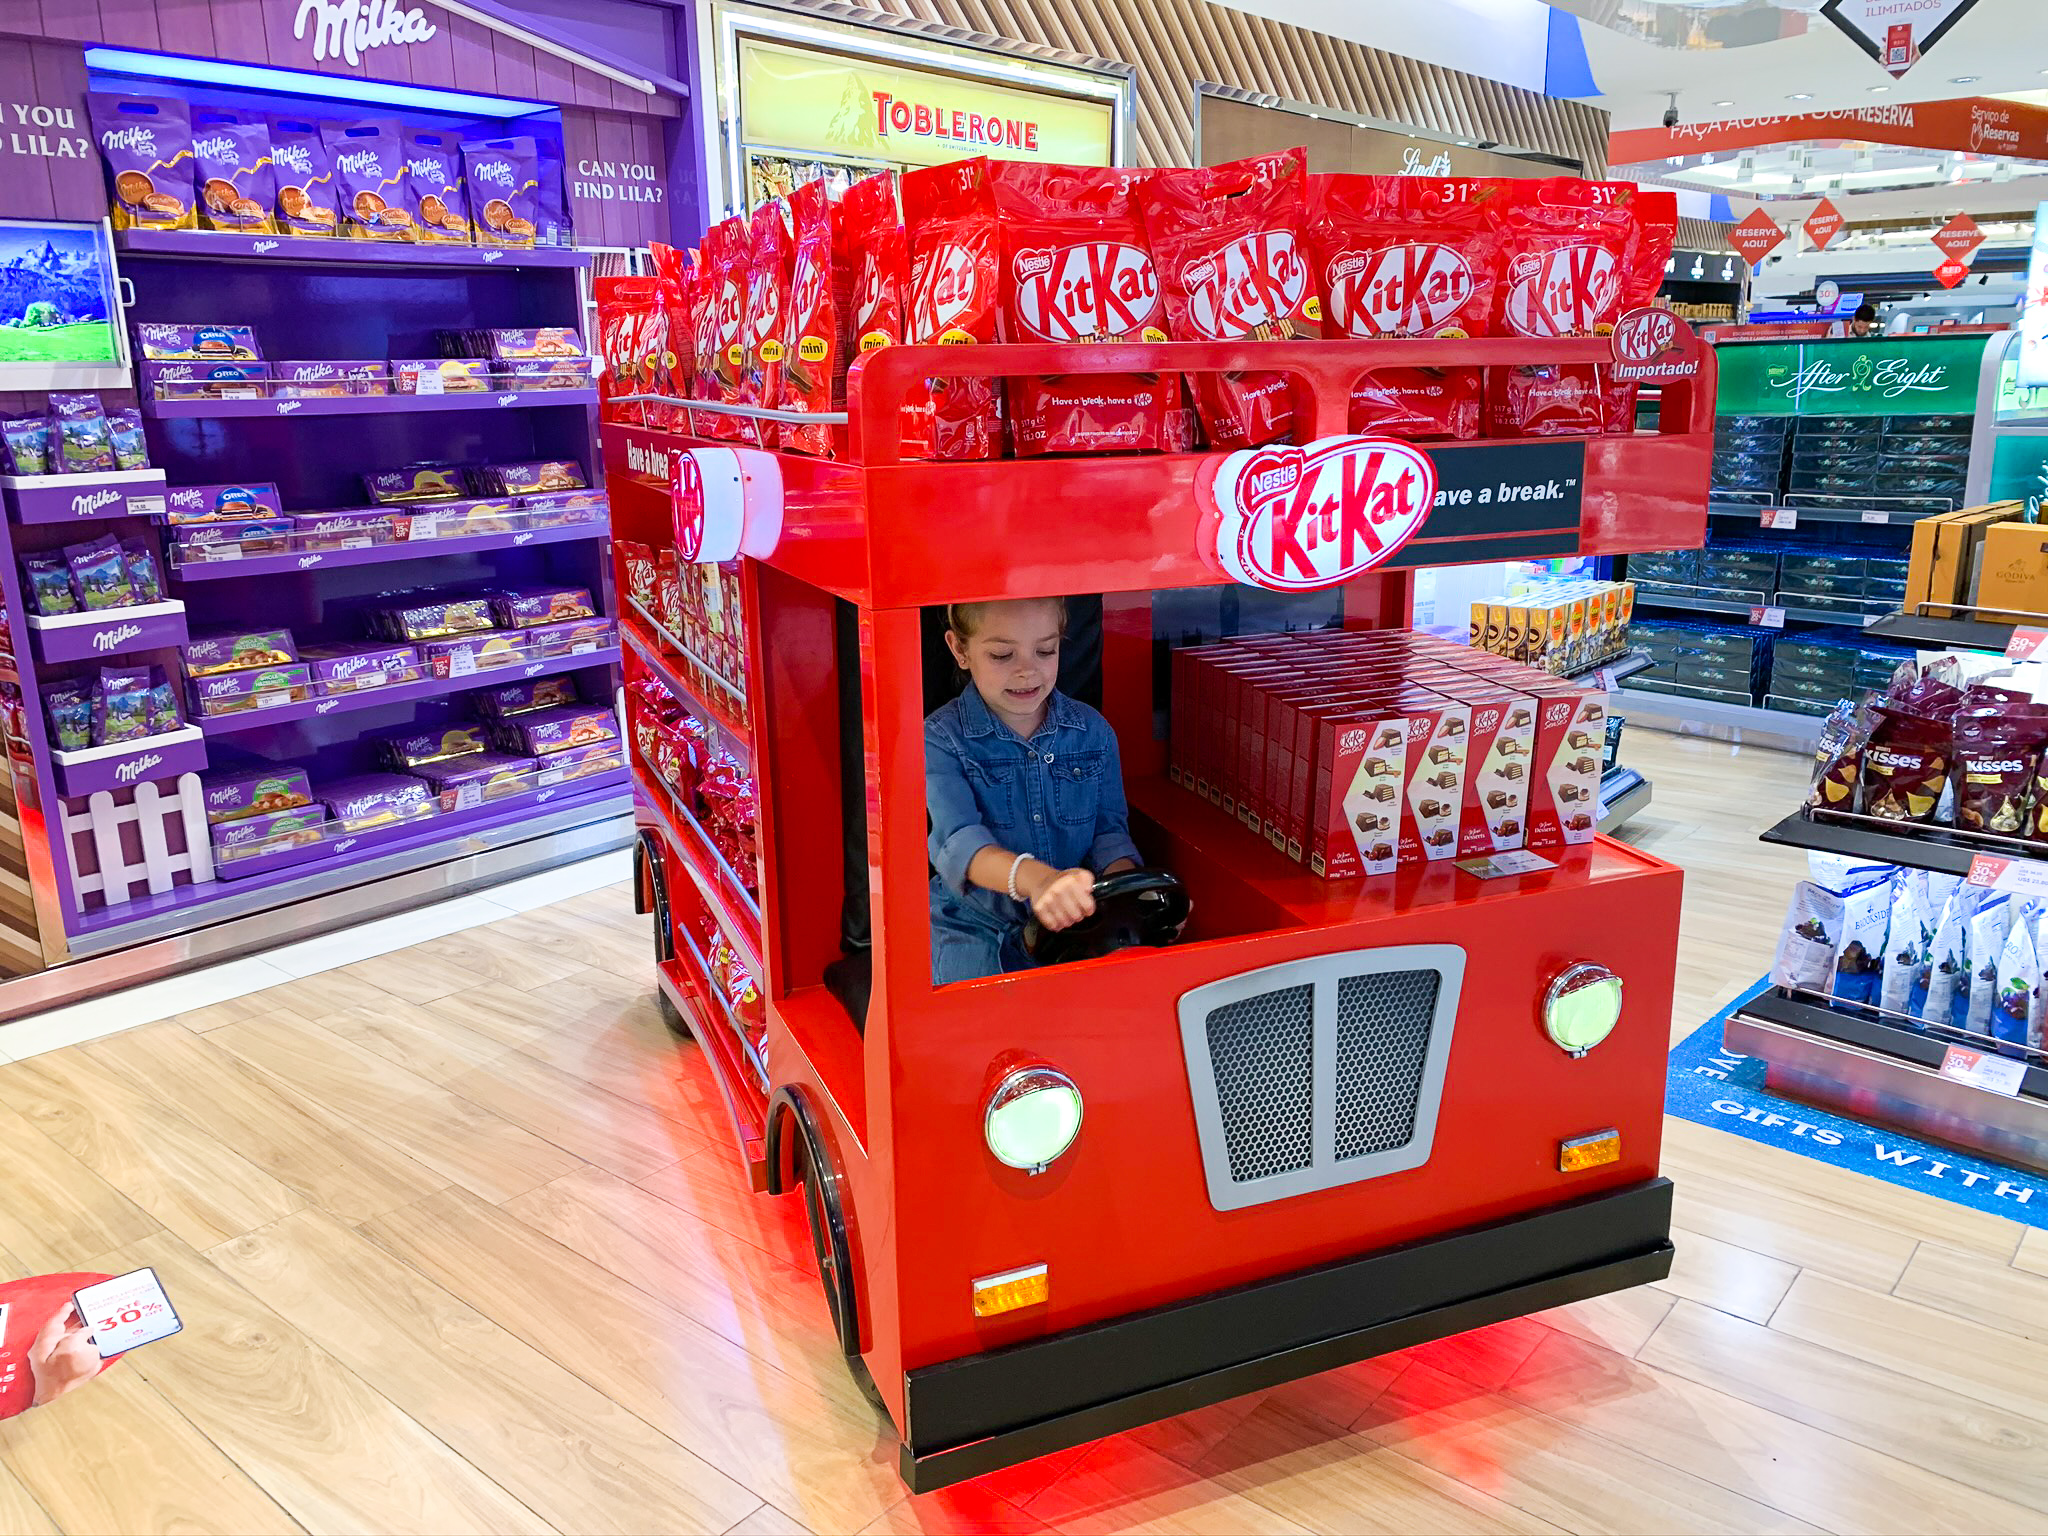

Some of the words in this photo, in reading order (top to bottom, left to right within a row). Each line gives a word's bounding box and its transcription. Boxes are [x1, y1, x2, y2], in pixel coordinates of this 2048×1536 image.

[1865, 0, 1941, 17] ILIMITADOS
[294, 0, 437, 66] Milka
[12, 103, 75, 129] YOU
[872, 91, 1038, 152] TOBLERONE
[1670, 121, 1722, 140] FAÇA
[1857, 105, 1914, 128] RESERVA
[1971, 105, 1999, 125] Serviço
[2000, 109, 2010, 123] de
[101, 126, 155, 150] Milka
[1983, 124, 2019, 142] Reservas
[11, 133, 89, 159] LILA?
[192, 136, 236, 159] Milka
[271, 145, 311, 166] Milka
[337, 150, 379, 174] Milka
[1398, 147, 1442, 176] Lindt
[408, 158, 442, 178] Milka
[474, 161, 512, 181] Milka
[578, 160, 615, 178] CAN
[620, 163, 655, 181] YOU
[574, 182, 615, 200] FIND
[619, 185, 663, 203] LILA?
[1809, 215, 1838, 225] RESERVE
[1736, 228, 1777, 237] RESERVE
[1814, 226, 1831, 234] AQUI
[1940, 230, 1978, 238] RESERVE
[253, 241, 279, 253] Milka
[1743, 240, 1768, 248] AQUI
[482, 250, 503, 262] Milka
[1019, 257, 1051, 272] Nestlé
[1332, 255, 1367, 273] Nestlé
[1186, 262, 1214, 283] Nestlé
[1514, 259, 1541, 277] Nestlé
[1034, 244, 1156, 341] KitKat
[1206, 233, 1301, 338] KitKat
[1344, 245, 1467, 338] KitKat
[501, 329, 524, 342] Milka
[1623, 314, 1673, 358] KitKat
[763, 344, 778, 356] mini
[801, 343, 823, 354] mini
[864, 340, 885, 350] mini
[294, 363, 334, 384] Milka
[1619, 361, 1699, 379] Importado!
[1771, 359, 1850, 398] After
[1873, 358, 1949, 398] Eight
[498, 394, 518, 406] Milka
[1052, 397, 1072, 406] Have
[1107, 396, 1126, 405] have
[1242, 391, 1261, 401] Have
[1529, 389, 1546, 397] Have
[277, 400, 301, 413] Milka
[1036, 430, 1046, 439] OZ
[1233, 427, 1244, 436] OZ
[626, 438, 645, 472] Have
[645, 449, 651, 474] a
[650, 442, 669, 480] brea
[378, 473, 402, 487] Milka
[506, 466, 528, 480] Milka
[1251, 466, 1298, 494] Nestlé
[72, 490, 122, 515] Milka
[170, 489, 203, 506] Milka
[223, 492, 248, 500] OREO
[1432, 489, 1472, 508] ave
[1478, 489, 1491, 504] a
[1271, 453, 1416, 578] KitKat
[314, 517, 353, 537] Milka
[513, 532, 533, 545] Milka
[299, 554, 322, 568] Milka
[1996, 571, 2035, 581] GODIVA
[93, 624, 141, 651] Milka
[2011, 637, 2035, 648] 50%
[188, 641, 218, 658] Milka
[332, 657, 369, 679] Milka
[525, 664, 544, 677] Milka
[208, 677, 240, 696] Milka
[316, 700, 339, 714] Milka
[1546, 703, 1570, 721] KitKat
[1475, 710, 1498, 727] KitKat
[538, 722, 560, 738] Milka
[1474, 722, 1497, 737] Senses
[1342, 730, 1366, 748] KitKat
[1339, 742, 1365, 758] Senses
[115, 754, 162, 782] Milka
[210, 787, 240, 804] Milka
[537, 789, 555, 802] Milka
[225, 825, 256, 842] Milka
[1464, 833, 1486, 841] Desserts
[1534, 826, 1557, 834] Desserts
[334, 838, 356, 853] Milka
[1398, 842, 1418, 850] esserts
[1331, 857, 1355, 865] Desserts
[1975, 859, 1992, 868] Leve
[1971, 874, 1988, 882] Off
[1973, 866, 1997, 878] 30%
[1950, 1051, 1967, 1059] Leve
[1711, 1099, 1845, 1146] GIFTS
[1872, 1144, 2034, 1205] WITH
[116, 1300, 142, 1314] ATÉ
[145, 1308, 163, 1317] OFF
